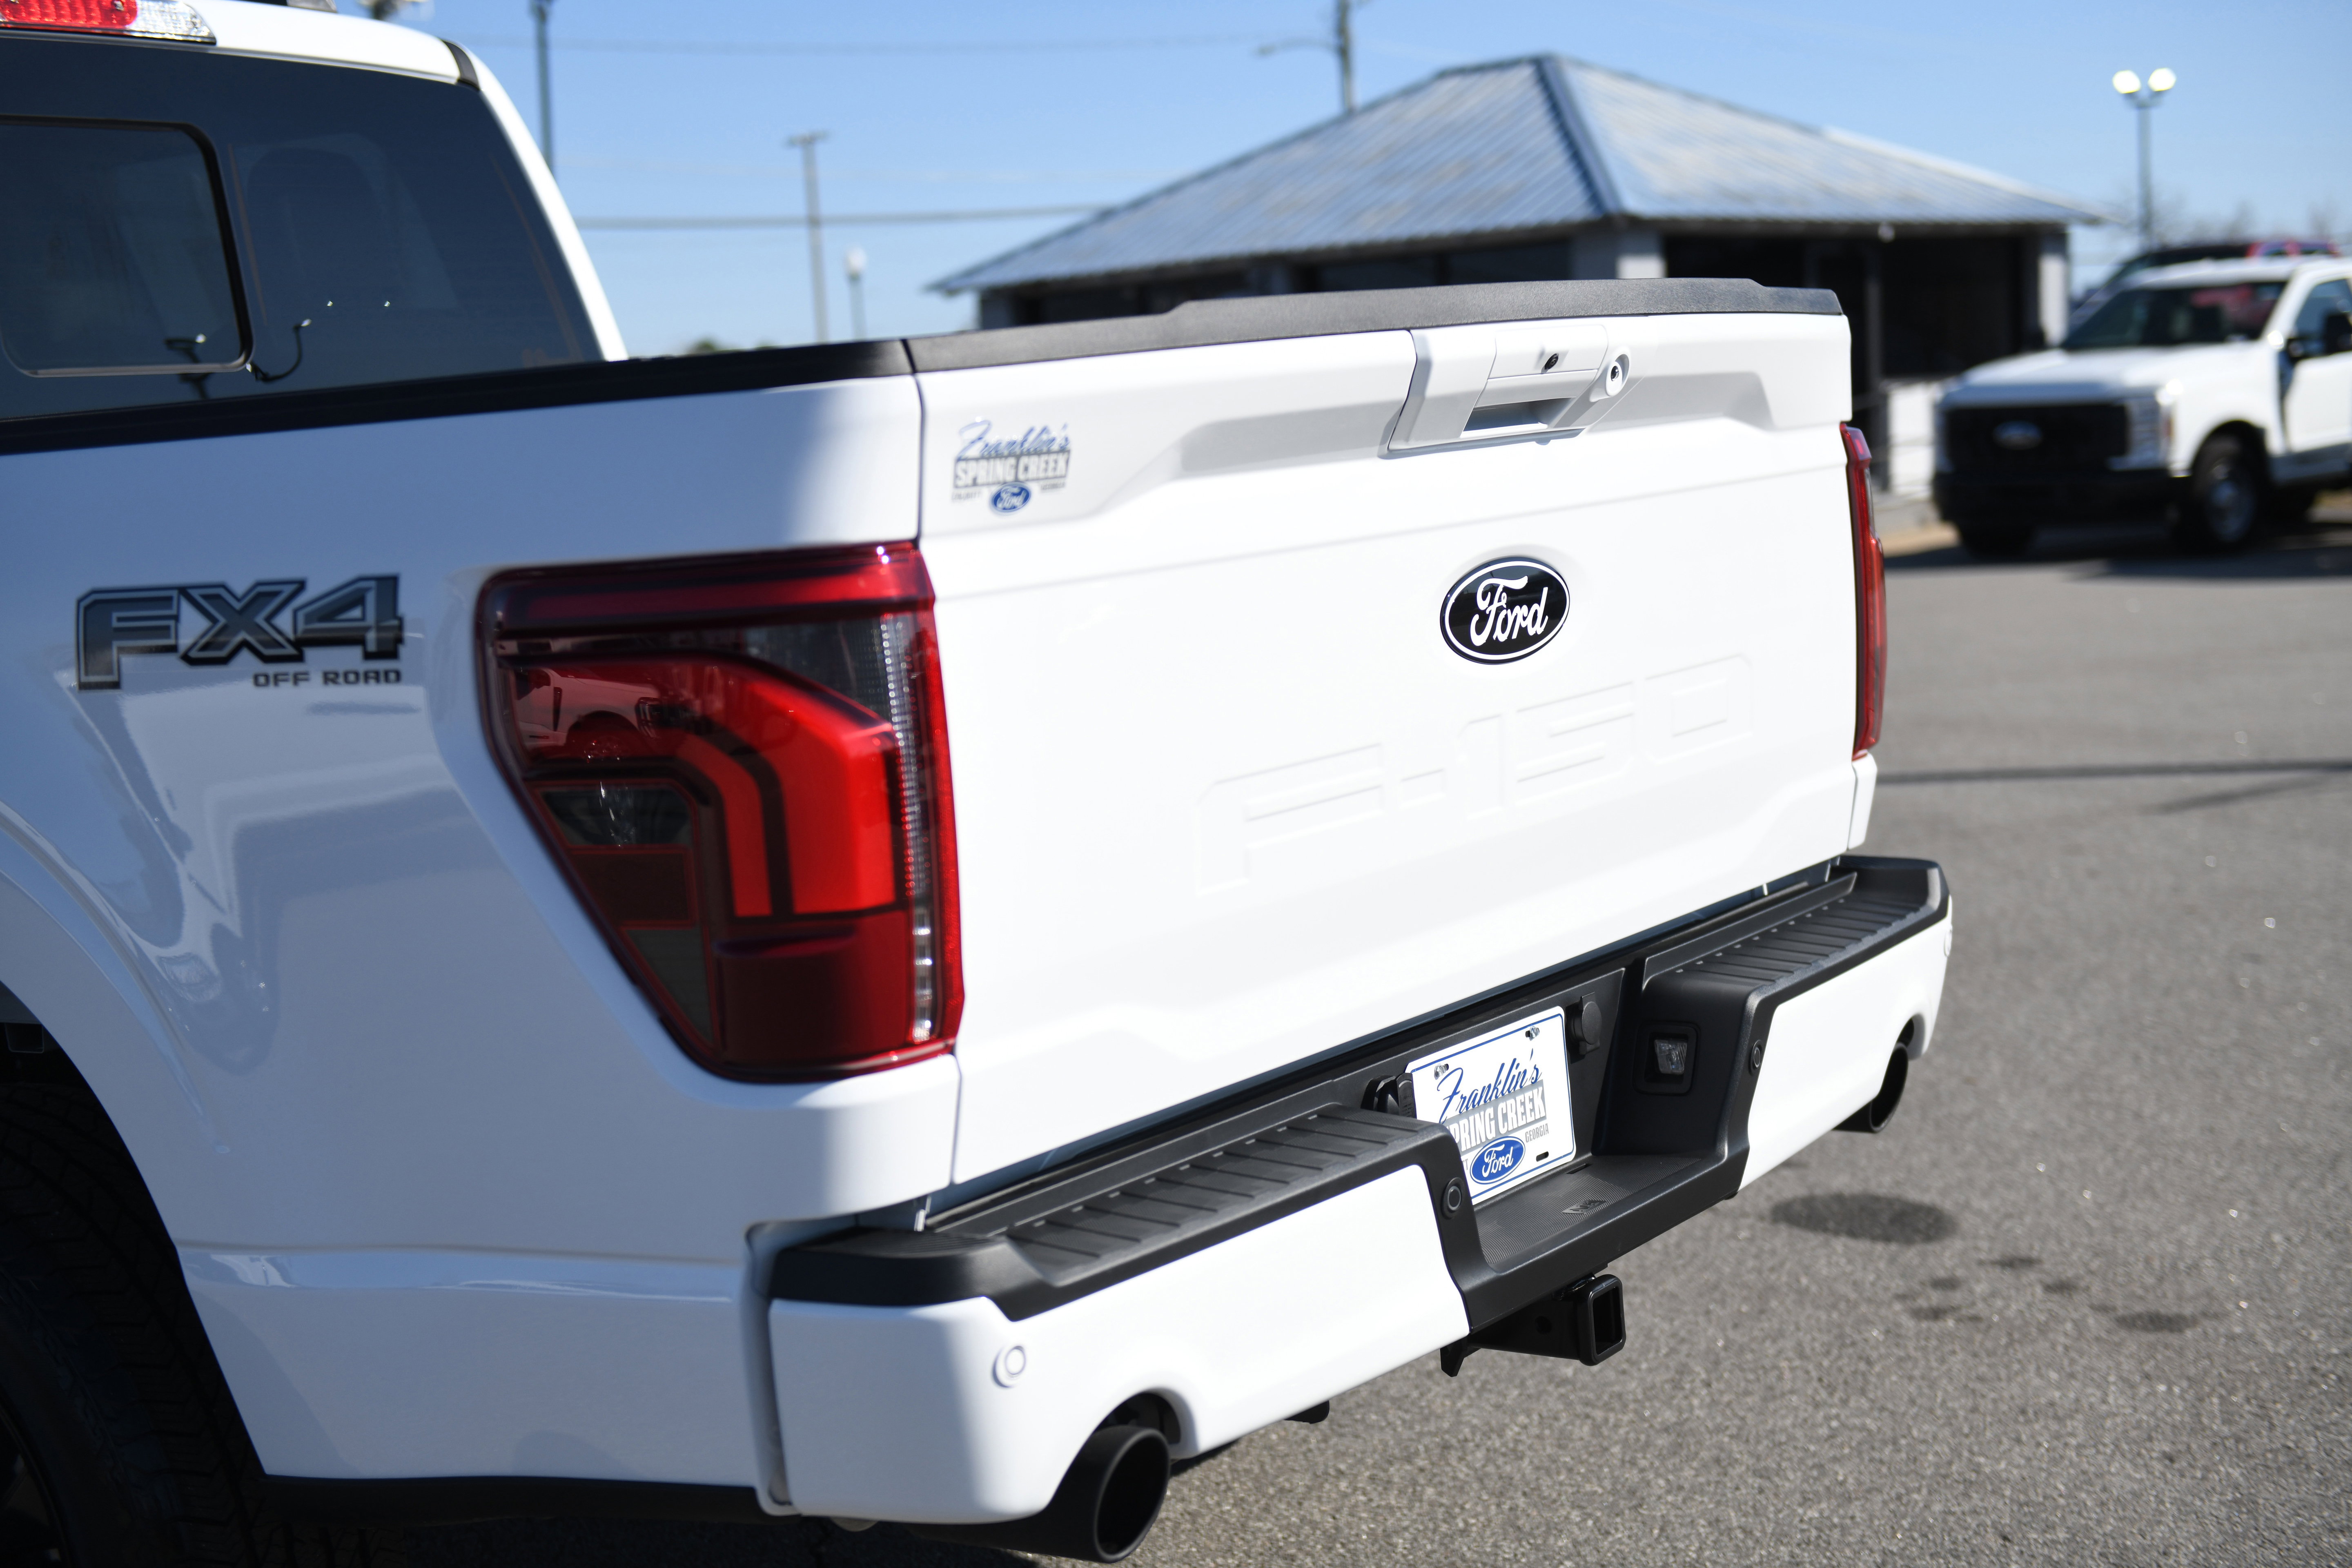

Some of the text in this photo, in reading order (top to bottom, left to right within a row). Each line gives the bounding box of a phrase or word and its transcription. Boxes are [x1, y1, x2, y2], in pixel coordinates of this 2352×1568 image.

[956, 451, 1069, 487] SPRING CREEK
[76, 573, 404, 690] FX4
[1470, 575, 1548, 646] Ford
[253, 669, 402, 687] OFF ROAD
[1193, 653, 1754, 898] F-150
[1437, 1048, 1542, 1124] Franklin's
[1446, 1107, 1496, 1152] PRING
[1497, 1086, 1546, 1134] CREEK
[1482, 1143, 1514, 1178] Ford
[1525, 1123, 1549, 1143] GEORGIA
